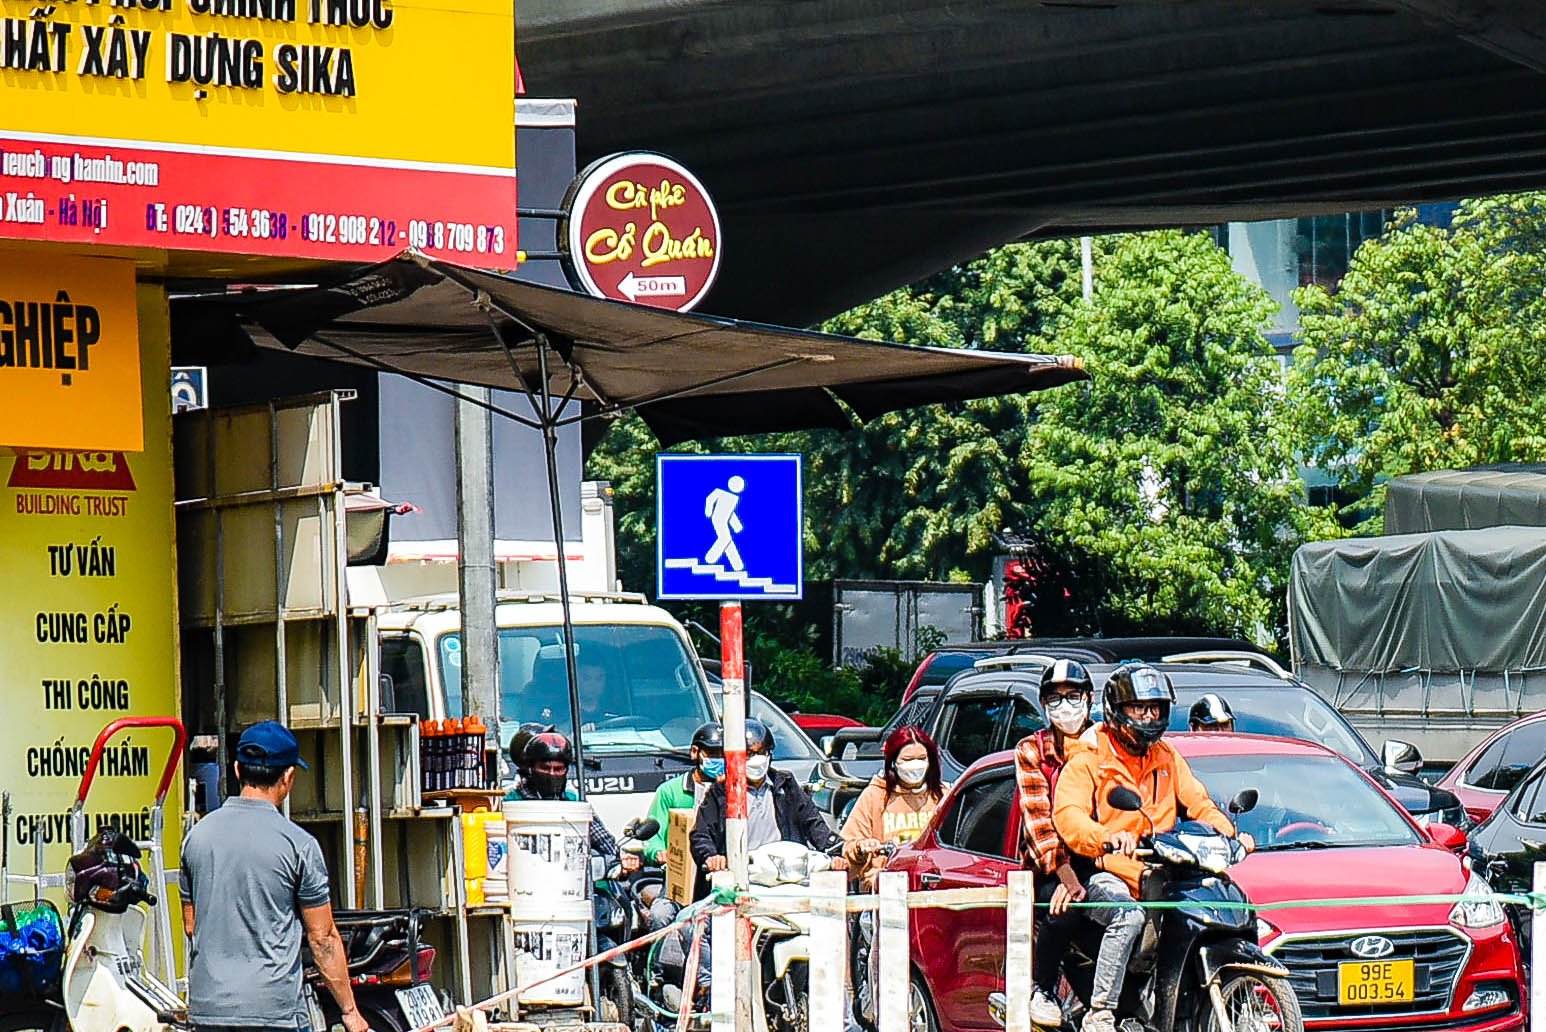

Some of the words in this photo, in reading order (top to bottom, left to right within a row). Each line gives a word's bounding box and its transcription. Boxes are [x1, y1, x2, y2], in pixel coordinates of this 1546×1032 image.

[78, 15, 151, 79] XÂY
[166, 33, 264, 99] DỰNG
[272, 44, 356, 97] SIKA
[606, 180, 648, 209] Cà
[649, 179, 687, 221] phê
[5, 192, 45, 223] Xuân
[59, 193, 77, 225] Hà
[250, 209, 287, 239] 3638
[302, 213, 337, 243] 0912
[339, 215, 367, 244] 908
[369, 217, 396, 246] 212
[447, 222, 474, 252] 709
[476, 225, 504, 254] 873
[585, 222, 636, 265] Cổ
[641, 221, 714, 267] Quán
[637, 280, 677, 292] 50m
[16, 494, 80, 515] BUILDING
[84, 496, 128, 516] TRUST
[48, 543, 73, 576] TƯ
[76, 536, 115, 576] VẤN
[36, 613, 88, 643] CUNG
[93, 603, 131, 643] CẤP
[42, 680, 71, 709] THI
[78, 674, 129, 710] CÔNG
[27, 736, 90, 776] CHỐNG
[100, 736, 149, 776] THẤM
[1348, 982, 1404, 1000] 003.54
[1361, 964, 1392, 981] 99E
